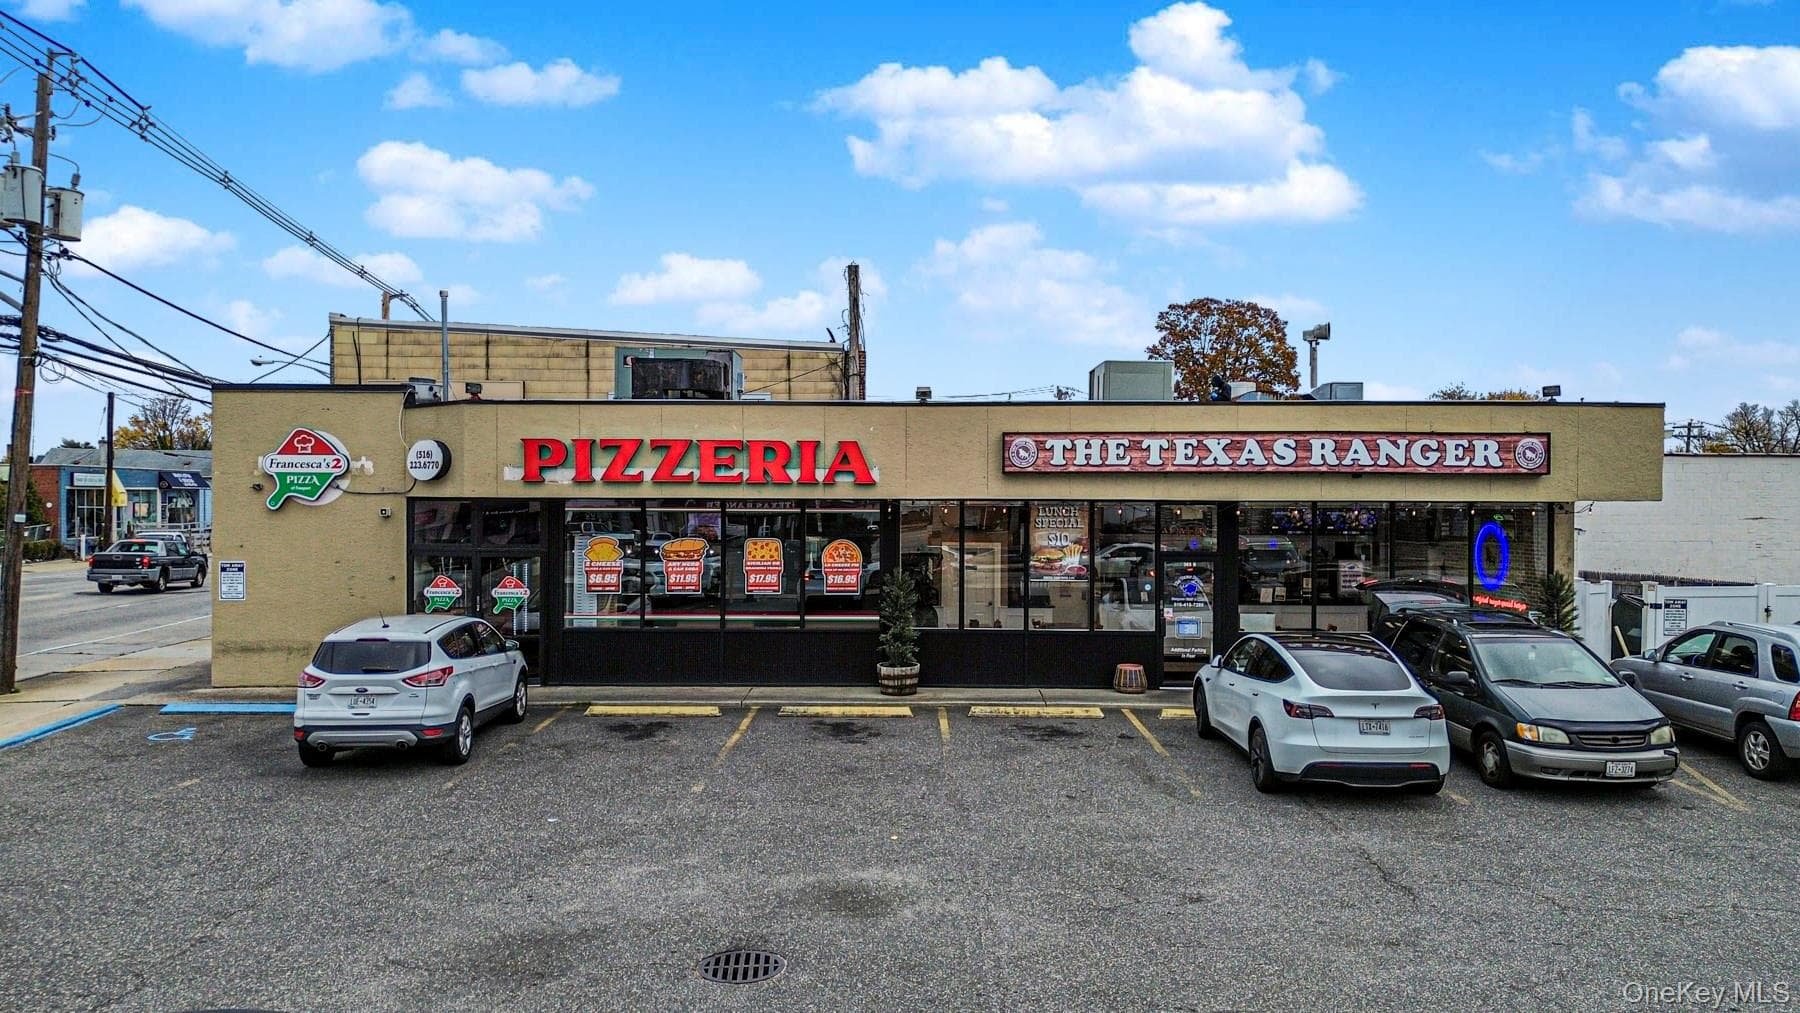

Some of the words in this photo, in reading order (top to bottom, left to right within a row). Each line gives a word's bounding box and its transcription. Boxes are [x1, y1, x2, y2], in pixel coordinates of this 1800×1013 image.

[416, 450, 433, 460] (516)
[1045, 438, 1132, 467] THE
[1141, 438, 1297, 467] TEXAS
[1308, 438, 1503, 468] RANGER
[269, 458, 331, 469] Francesca's
[331, 459, 343, 469] 2
[520, 438, 877, 485] PIZZERIA
[287, 474, 320, 486] PIZZA
[1038, 506, 1080, 517] LUNCH
[1035, 518, 1085, 528] SPECIAL
[1048, 531, 1070, 546] $10
[589, 573, 618, 584] $6.95
[669, 573, 698, 583] $11.95
[749, 574, 778, 584] $17.95
[827, 574, 857, 585] $16.95
